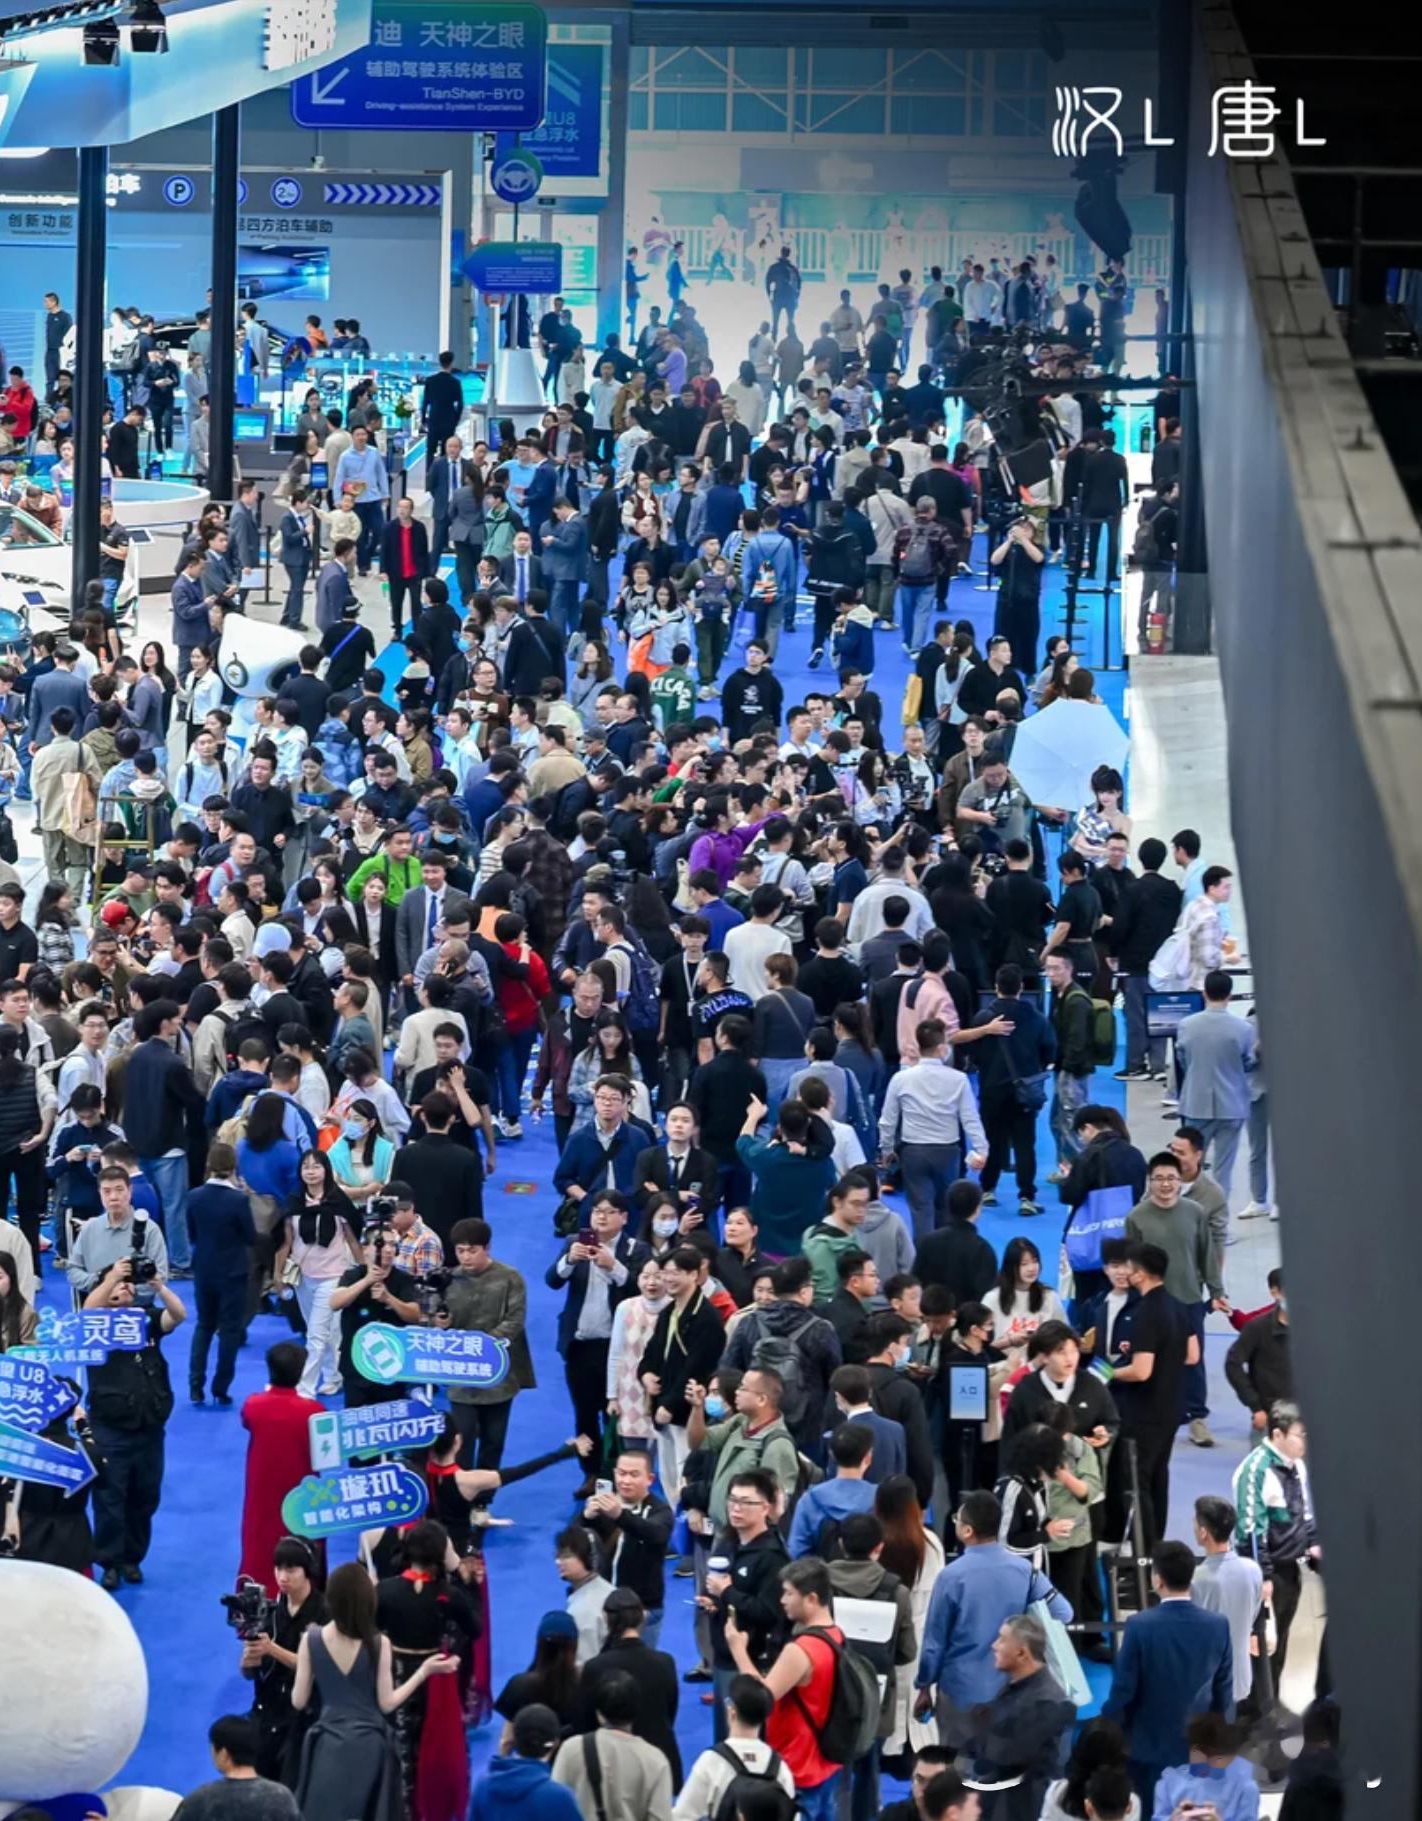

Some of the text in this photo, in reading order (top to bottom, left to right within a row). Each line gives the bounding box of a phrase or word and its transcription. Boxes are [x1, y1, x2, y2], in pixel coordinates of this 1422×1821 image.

[375, 19, 525, 49] 迪 天神之眼
[366, 60, 524, 79] 辅助驾驶系统体验区
[422, 87, 525, 101] TianShen-BYD
[8, 213, 74, 229] 创新功能
[406, 1331, 483, 1357] 天神之眼
[19, 1364, 46, 1385] U8
[415, 1358, 493, 1378] 辅助驾驶系统
[341, 1413, 447, 1450] 兆瓦闪充
[339, 1469, 405, 1502] 璇玑
[303, 1501, 383, 1526] 智能化架构
